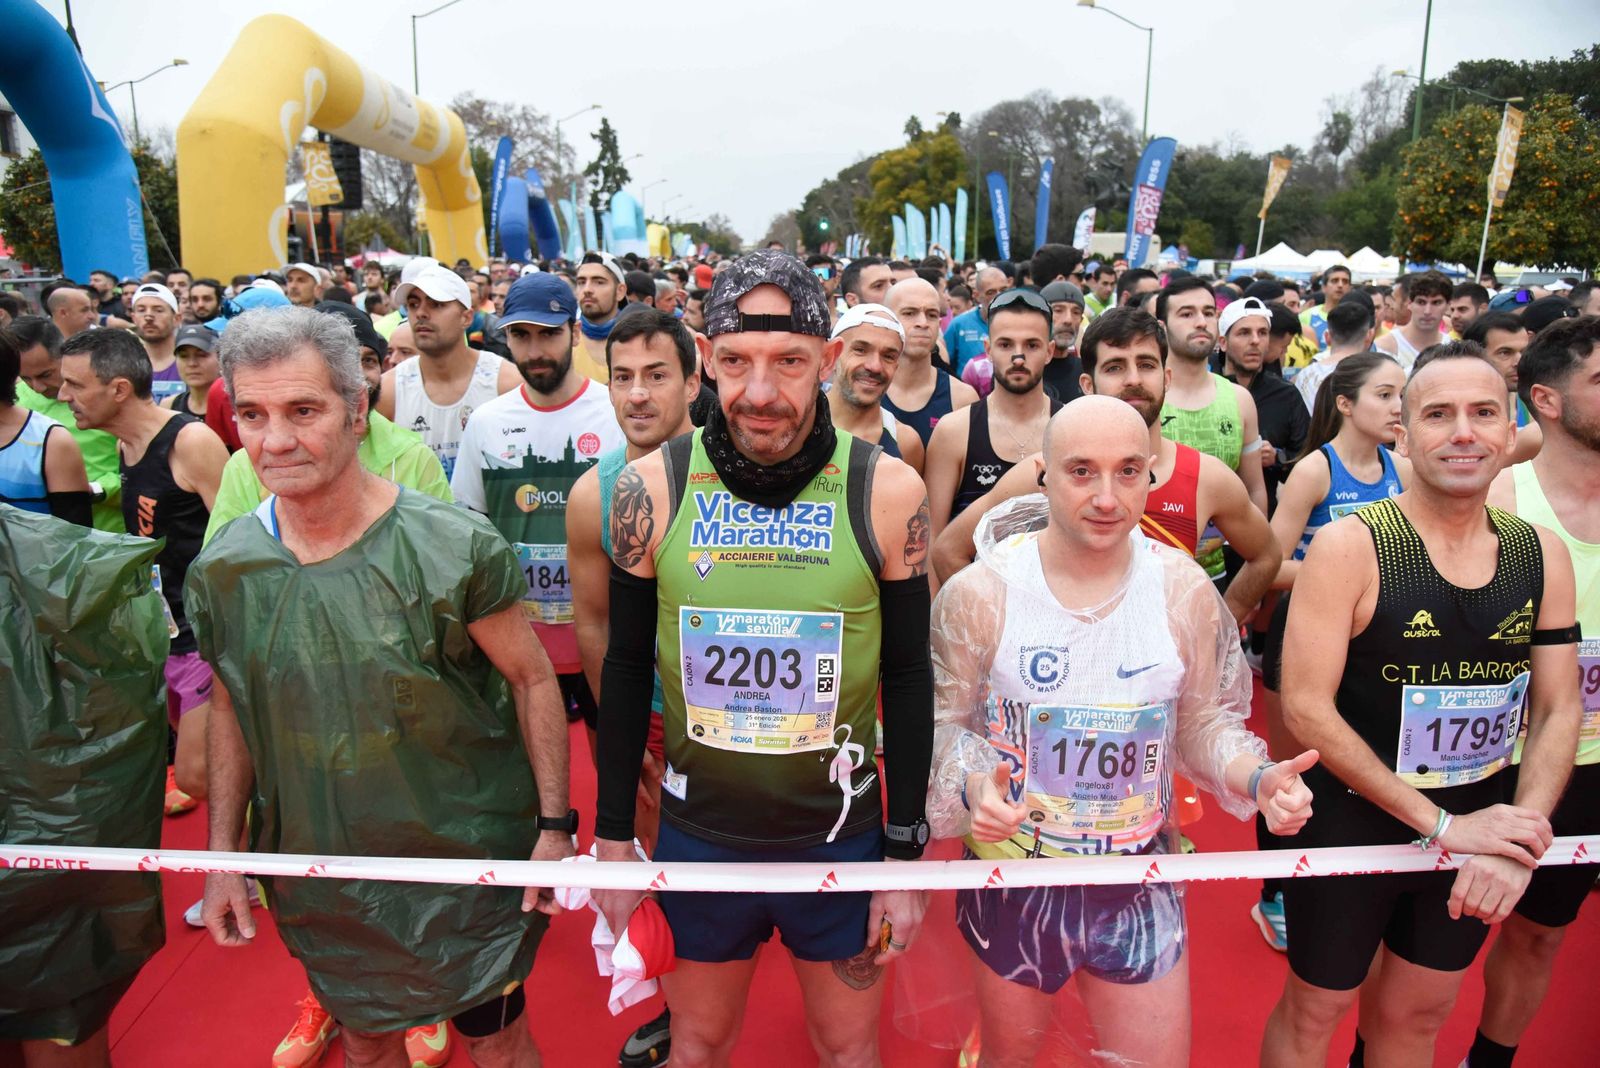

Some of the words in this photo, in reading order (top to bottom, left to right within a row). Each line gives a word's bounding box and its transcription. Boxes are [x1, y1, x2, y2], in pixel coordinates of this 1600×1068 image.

[1146, 160, 1161, 187] ress
[690, 472, 719, 480] MPS
[813, 476, 843, 495] iRun
[1335, 490, 1358, 500] vive
[694, 491, 834, 528] Vicenza
[1162, 502, 1184, 513] JAVI
[691, 521, 832, 552] Marathon
[718, 552, 775, 562] ACCIAIERIE
[777, 553, 830, 566] VALBRUNA
[525, 565, 570, 589] 184
[734, 614, 790, 625] maratón
[746, 624, 789, 634] sevilla
[1403, 630, 1442, 638] austral
[704, 645, 802, 690] 2203
[1382, 664, 1424, 684] C.T.
[1432, 662, 1452, 682] LA
[1038, 662, 1070, 693] MARATHON
[734, 691, 770, 700] ANDREA
[1456, 688, 1505, 698] maratón
[1466, 697, 1505, 706] sevilla
[724, 704, 752, 712] Andrea
[754, 704, 782, 714] Baston
[1080, 710, 1132, 720] maratón
[1092, 719, 1132, 730] sevilla
[1426, 712, 1506, 752] 1795
[730, 736, 752, 744] HOKA
[1052, 738, 1138, 780] 1768
[1440, 754, 1461, 762] Manu
[1462, 751, 1489, 761] Sánchez
[1075, 780, 1114, 790] angelox81
[1072, 792, 1098, 800] Angelo
